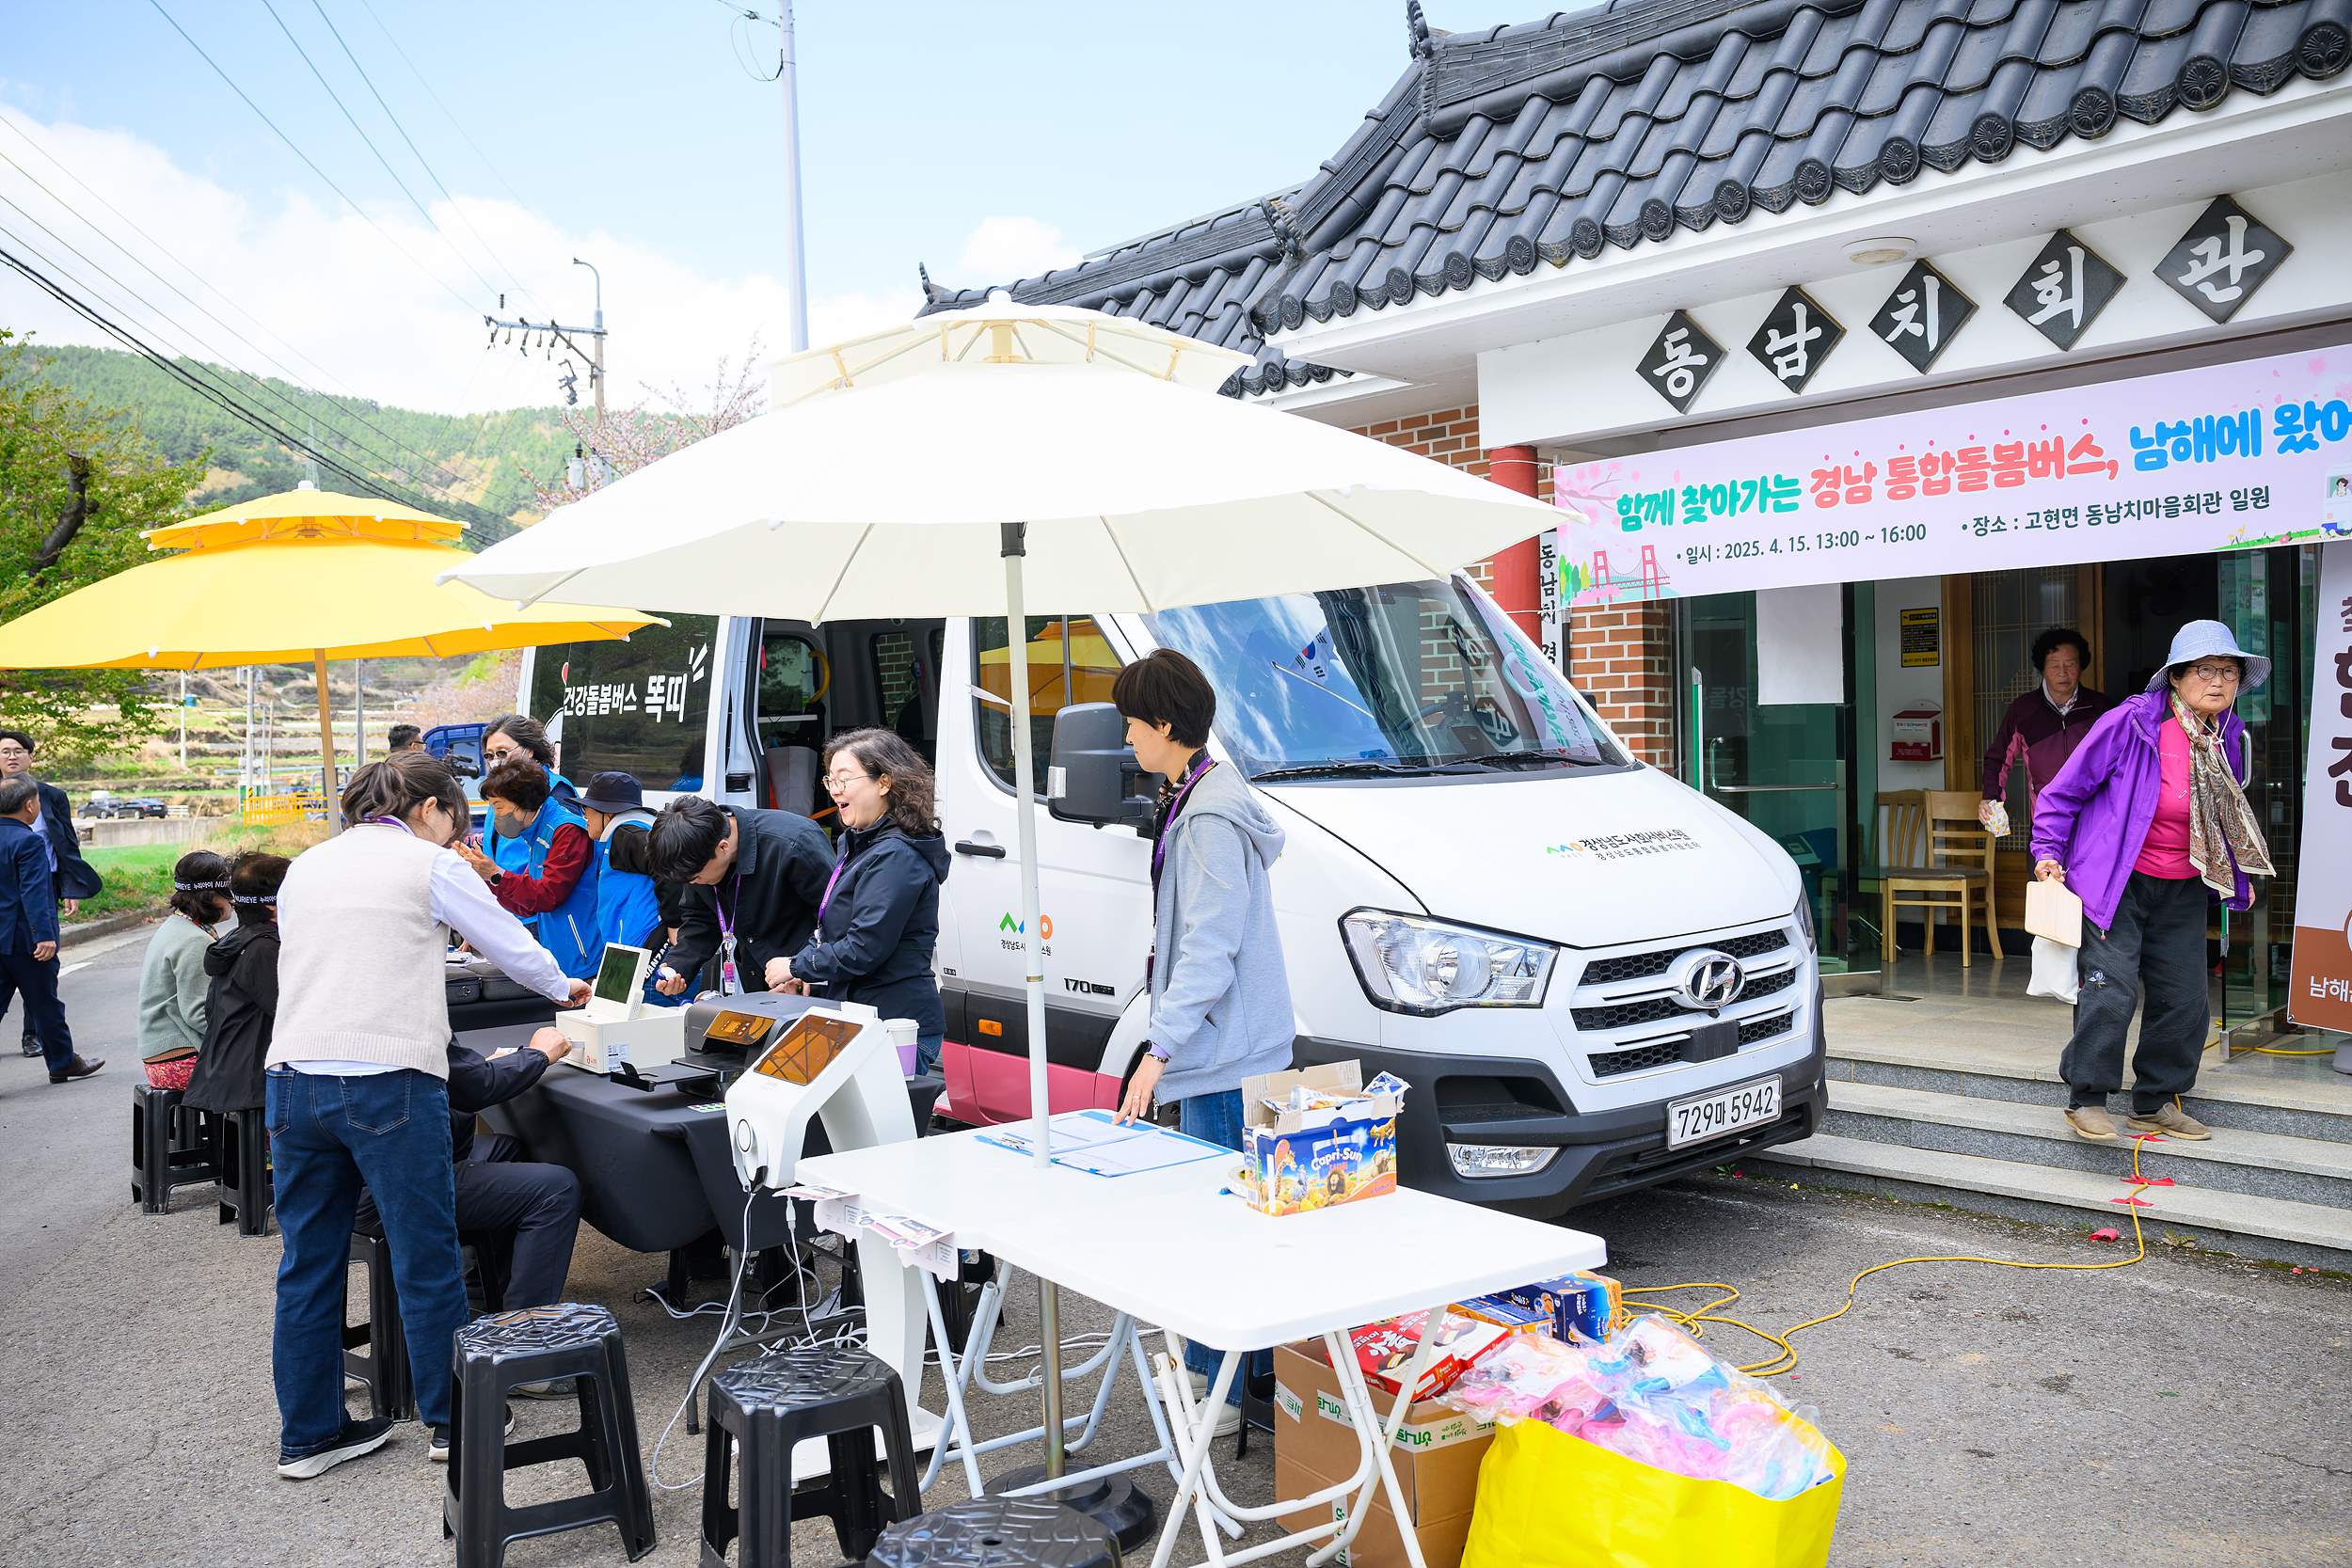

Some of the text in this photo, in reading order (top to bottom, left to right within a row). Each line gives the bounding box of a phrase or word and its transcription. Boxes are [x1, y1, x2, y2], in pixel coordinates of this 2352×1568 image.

[1653, 215, 2265, 398] 동남치회관
[1616, 487, 1676, 533] 함께
[1681, 472, 1803, 525] 찾아가는
[1809, 460, 1879, 510] 경남
[1884, 432, 2119, 501] 통합돌봄버스,
[2129, 407, 2263, 472] 남해에
[1972, 515, 2008, 537] 장소
[2025, 507, 2079, 531] 고현면
[2085, 490, 2223, 527] 동남치마을회관
[2229, 484, 2271, 511] 일원
[1685, 546, 1713, 565] 일시
[1724, 540, 1765, 561] 2025.
[1769, 537, 1784, 555] 4.
[1788, 534, 1811, 553] 15.
[1815, 530, 1860, 550] 13:00
[1881, 523, 1928, 544] 16:00
[564, 673, 689, 723] 건강돌봄버스 똑띠
[1579, 828, 1692, 852] 경상남도사회서비스원
[1064, 977, 1092, 993] 170
[2310, 974, 2352, 1004] 남해
[1677, 1085, 1773, 1138] 729마 5942
[1311, 1148, 1363, 1171] Capri-Sun
